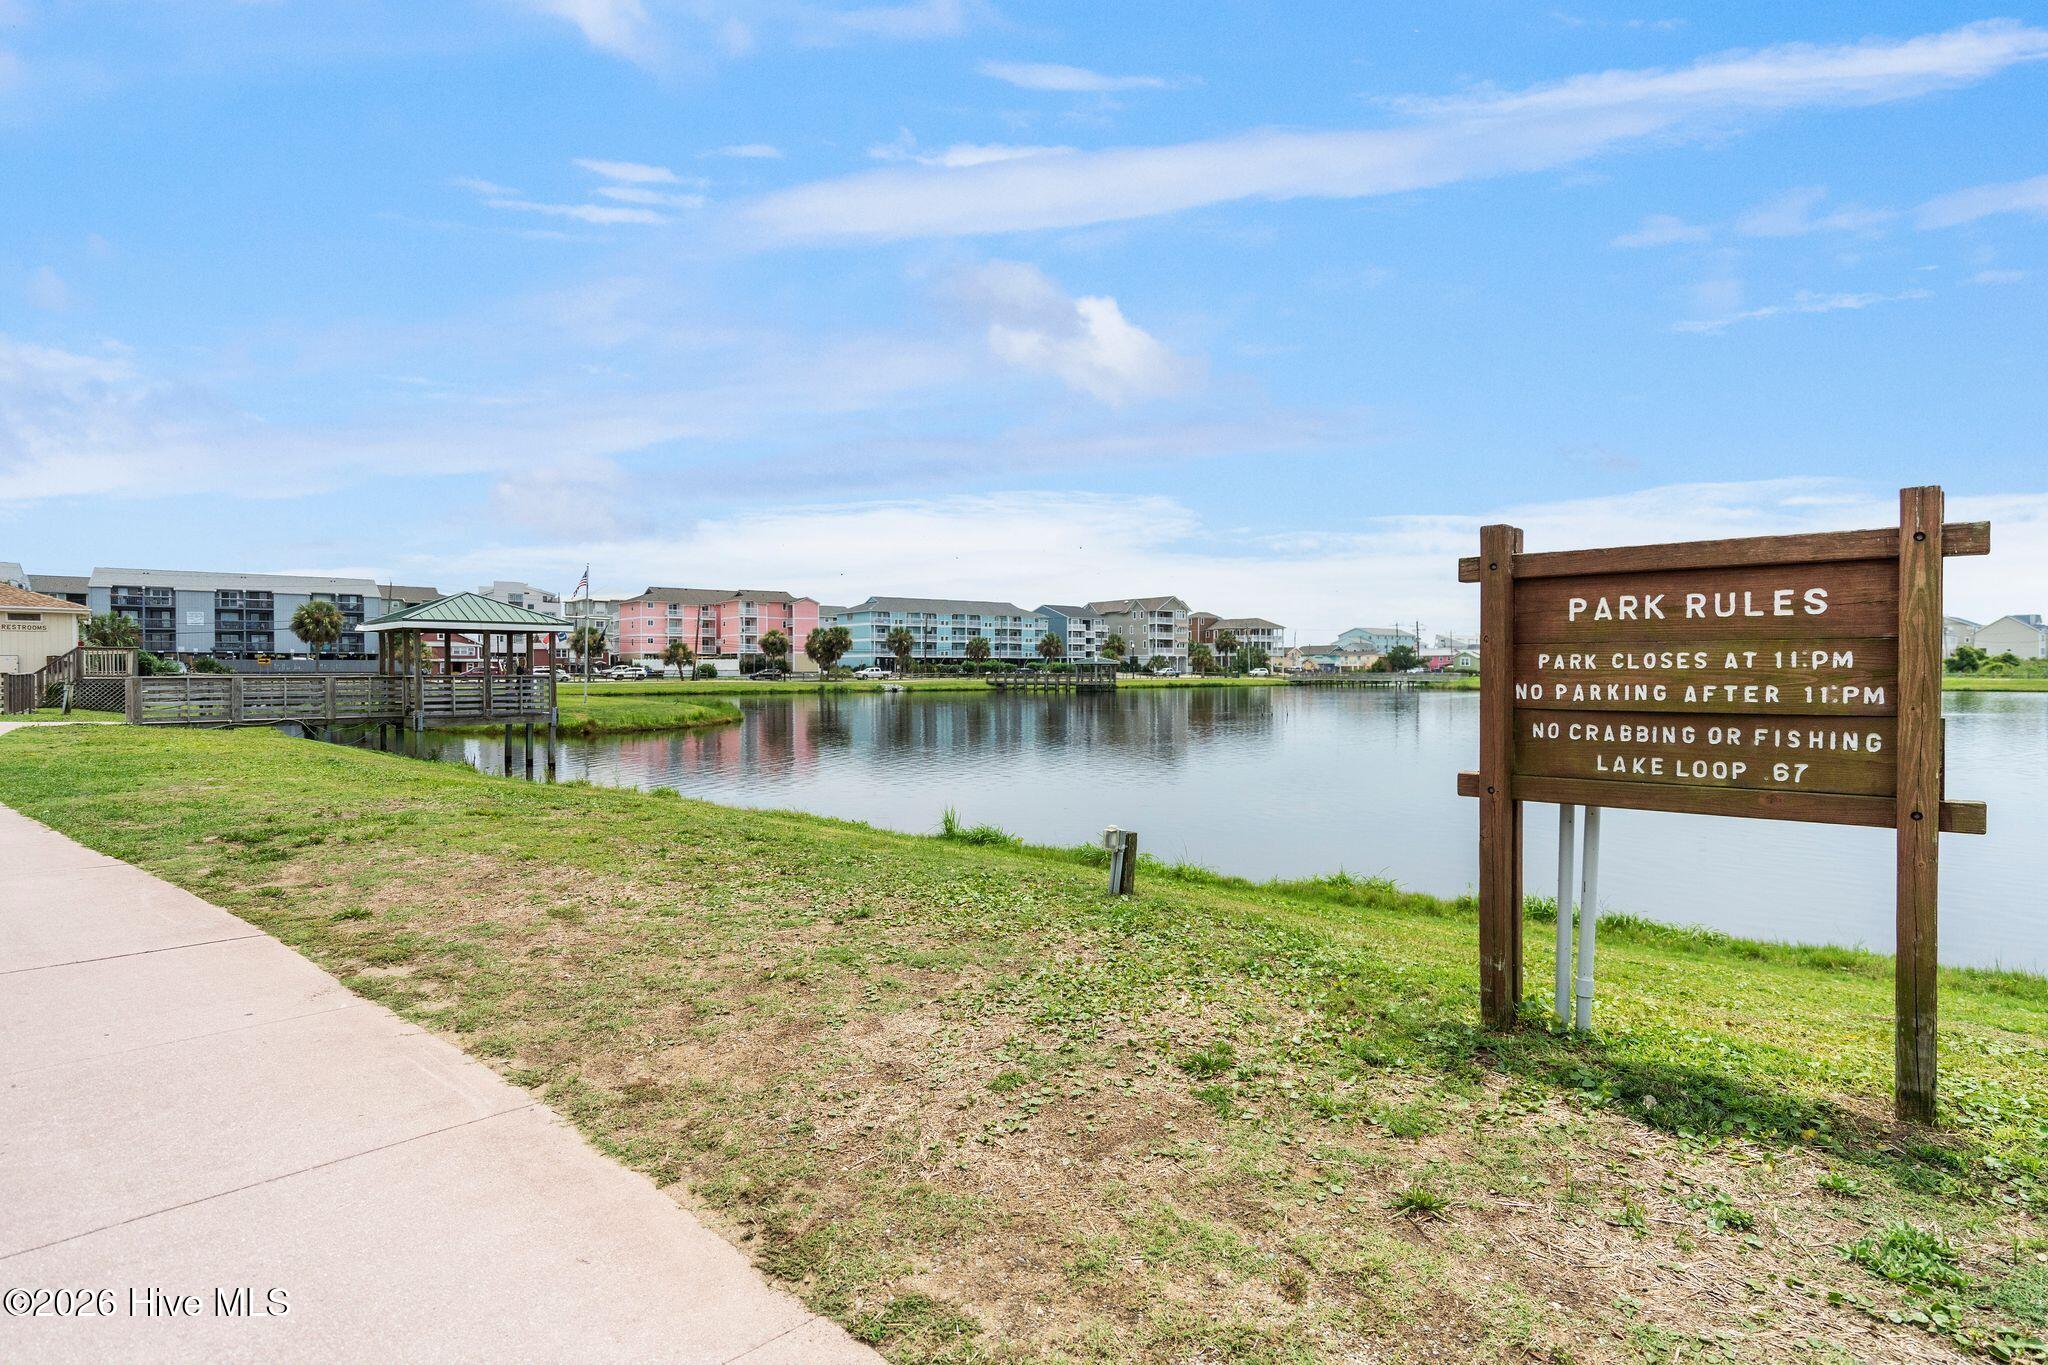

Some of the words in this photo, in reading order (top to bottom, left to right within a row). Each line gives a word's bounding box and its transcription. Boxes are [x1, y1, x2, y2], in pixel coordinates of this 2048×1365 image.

[1568, 593, 1666, 622] PARK
[1685, 587, 1828, 619] RULES
[1538, 653, 1597, 670] PARK
[1611, 651, 1708, 670] CLOSES
[1724, 651, 1758, 669] AT
[1515, 683, 1543, 700] NO
[1555, 683, 1667, 702] PARKING
[1684, 684, 1780, 703] AFTER
[1532, 722, 1560, 739] NO
[1569, 723, 1696, 744] CRABBING
[1707, 726, 1742, 746] OR
[1753, 728, 1882, 753] FISHING
[1597, 754, 1664, 775] LAKE
[1676, 760, 1747, 780] LOOP
